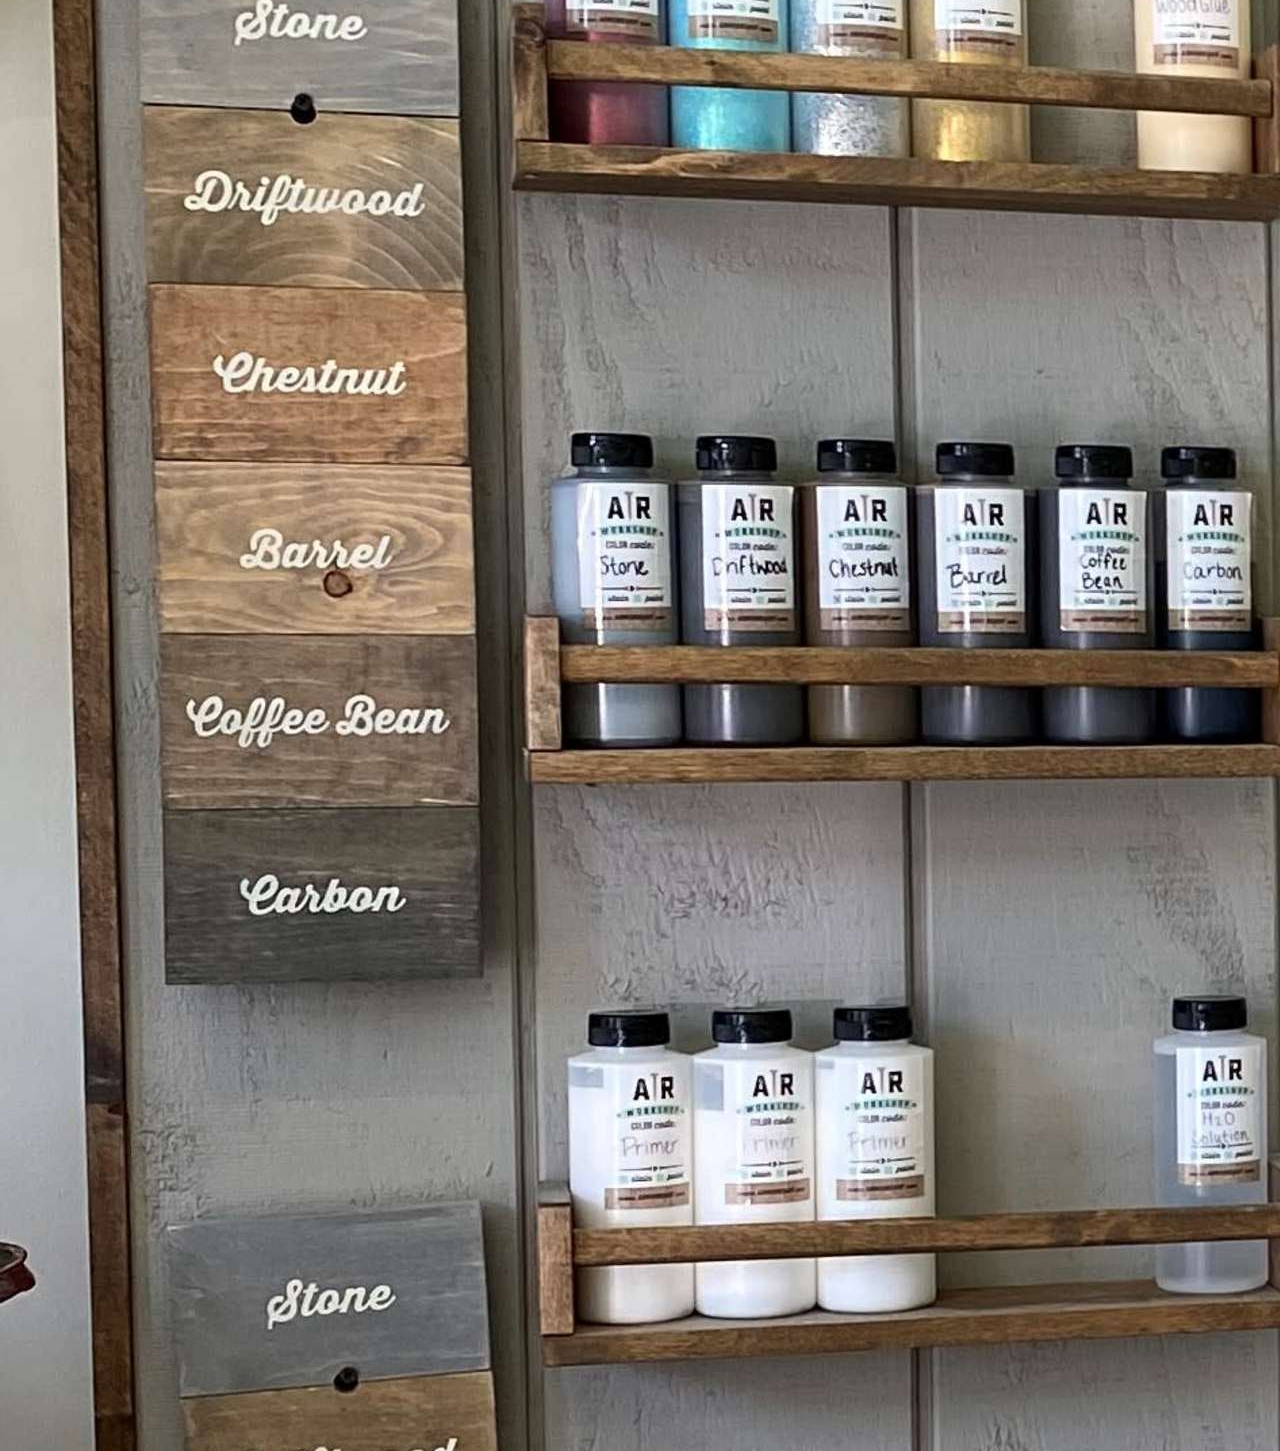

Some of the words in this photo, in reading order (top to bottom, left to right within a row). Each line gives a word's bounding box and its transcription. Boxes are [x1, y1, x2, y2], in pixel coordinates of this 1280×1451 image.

[184, 169, 426, 224] Driftwood
[213, 350, 407, 399] Chestnut
[240, 528, 392, 572] Barrel
[600, 556, 648, 576] Stone
[829, 557, 898, 578] Chestnut
[947, 563, 1007, 588] Barrel
[1082, 573, 1123, 589] Bean
[1184, 562, 1242, 580] Carbon
[186, 694, 328, 749] Coffee
[336, 696, 449, 739] Bean
[238, 872, 405, 918] Carbon
[621, 1136, 679, 1156] Primer
[266, 1279, 396, 1330] Stone
